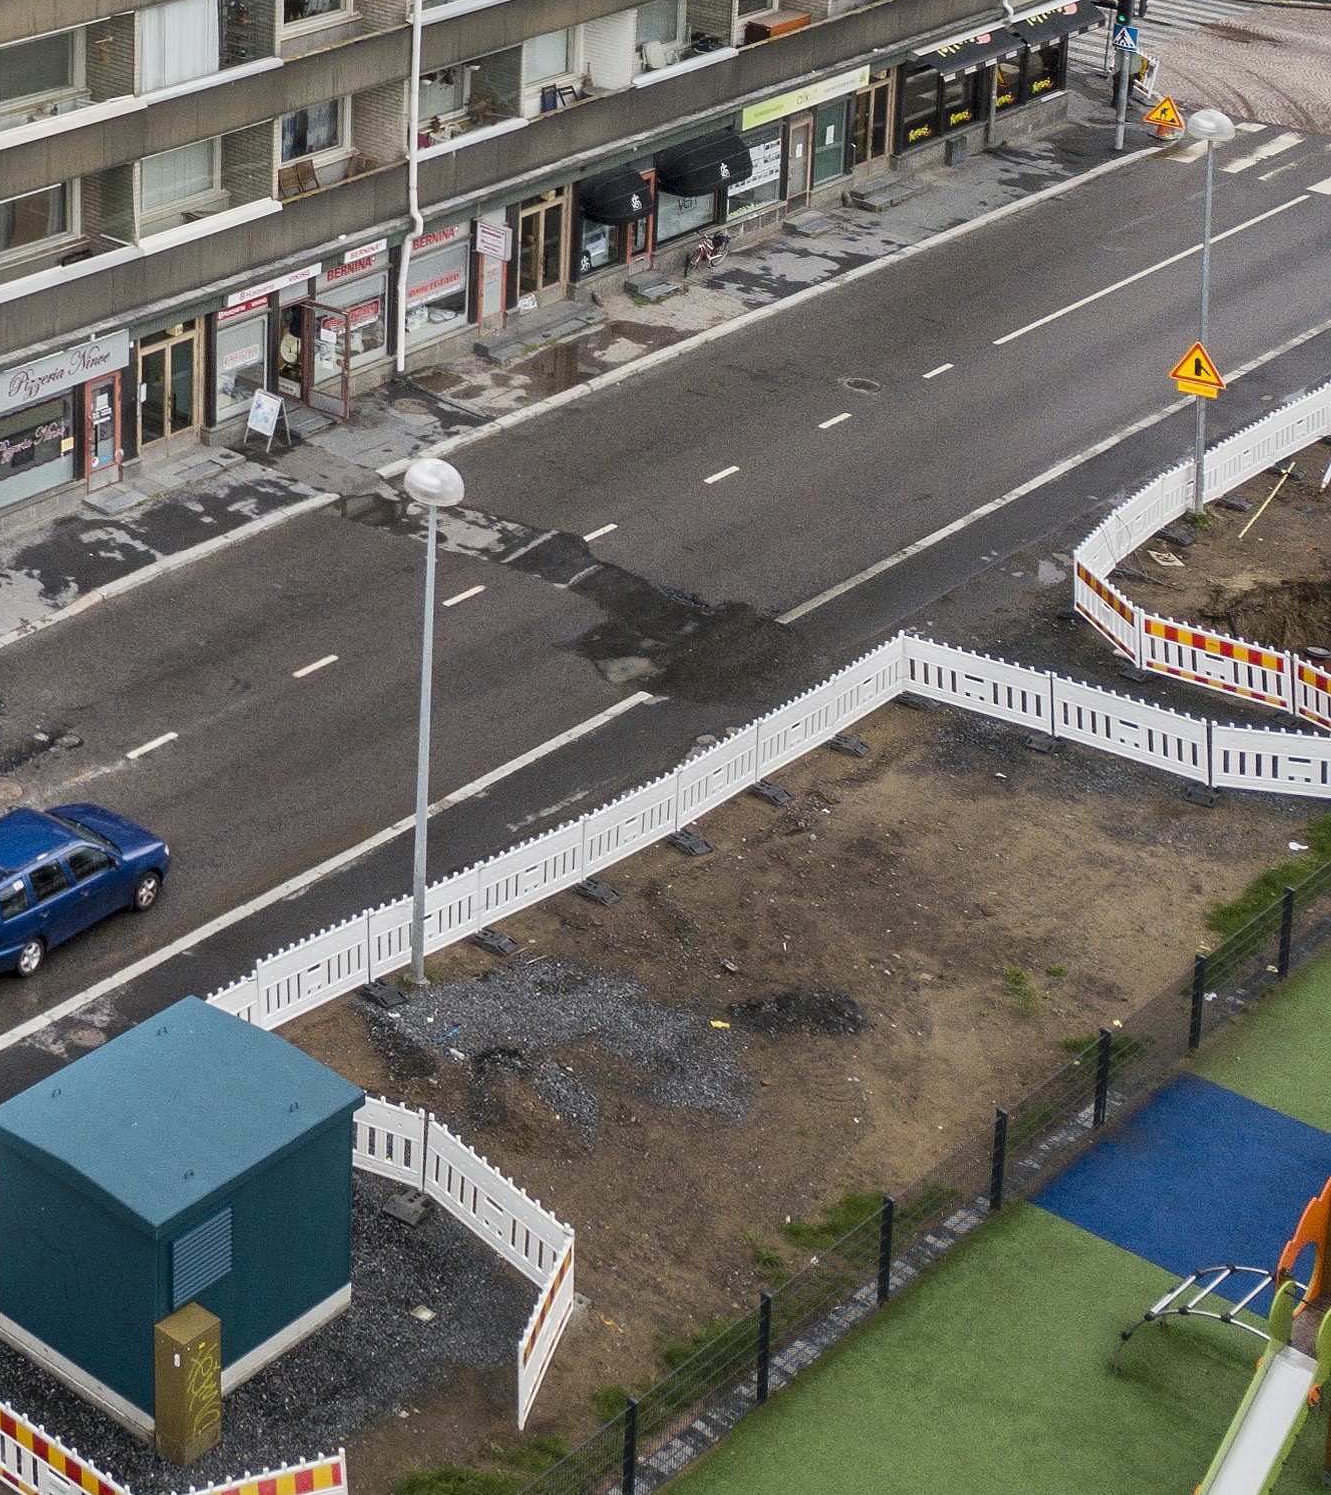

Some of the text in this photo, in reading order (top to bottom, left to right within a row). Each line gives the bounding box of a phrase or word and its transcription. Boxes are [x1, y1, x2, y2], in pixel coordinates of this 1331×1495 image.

[412, 227, 456, 251] BERNINA
[350, 243, 382, 260] BERNINA
[326, 259, 373, 282] BERNINA
[8, 368, 66, 402] Pizzeria
